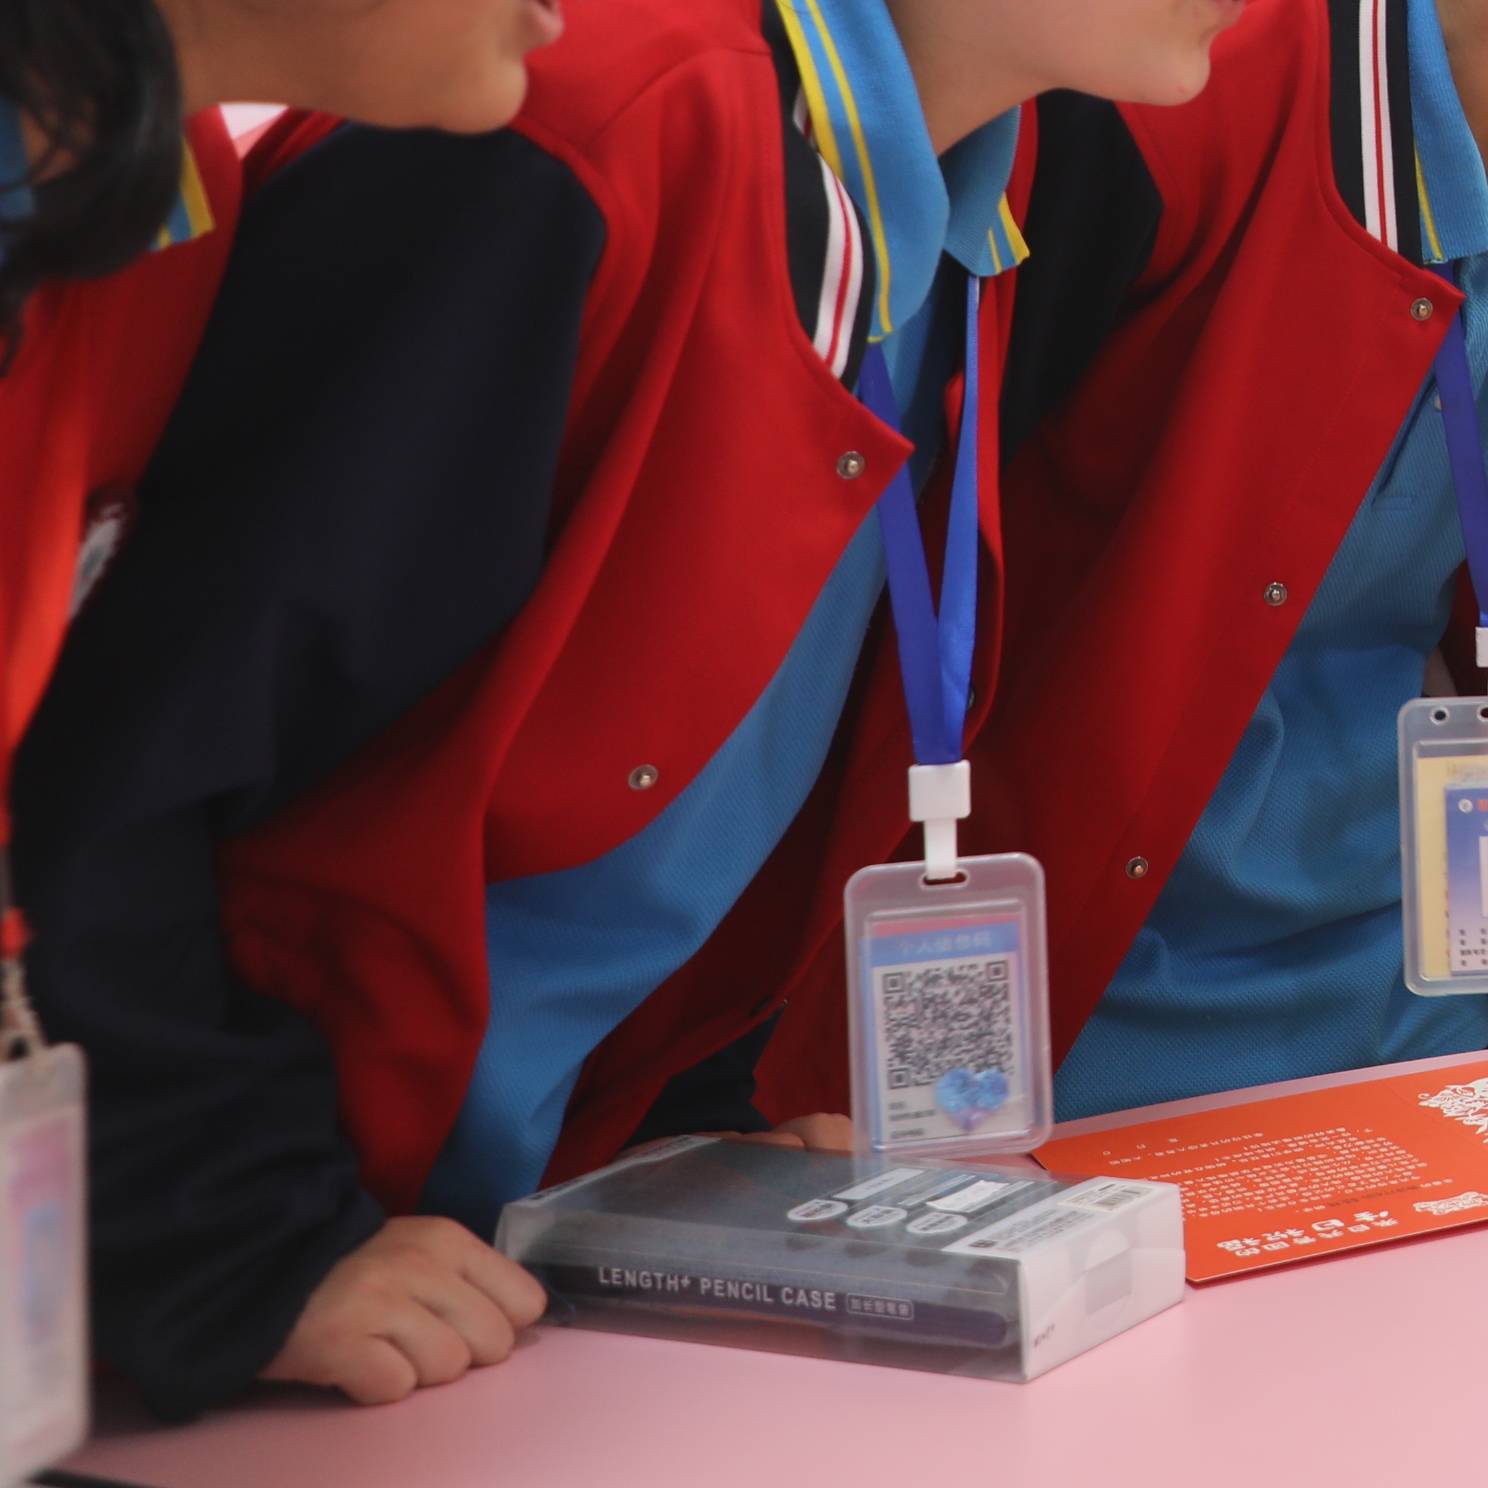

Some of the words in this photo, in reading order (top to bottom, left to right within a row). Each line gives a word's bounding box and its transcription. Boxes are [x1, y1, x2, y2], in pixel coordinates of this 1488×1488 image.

[1217, 1210, 1390, 1251] 生日祝福
[1235, 1218, 1399, 1257] 来自共青团的
[700, 1277, 774, 1304] PENCIL
[781, 1286, 837, 1311] CASE
